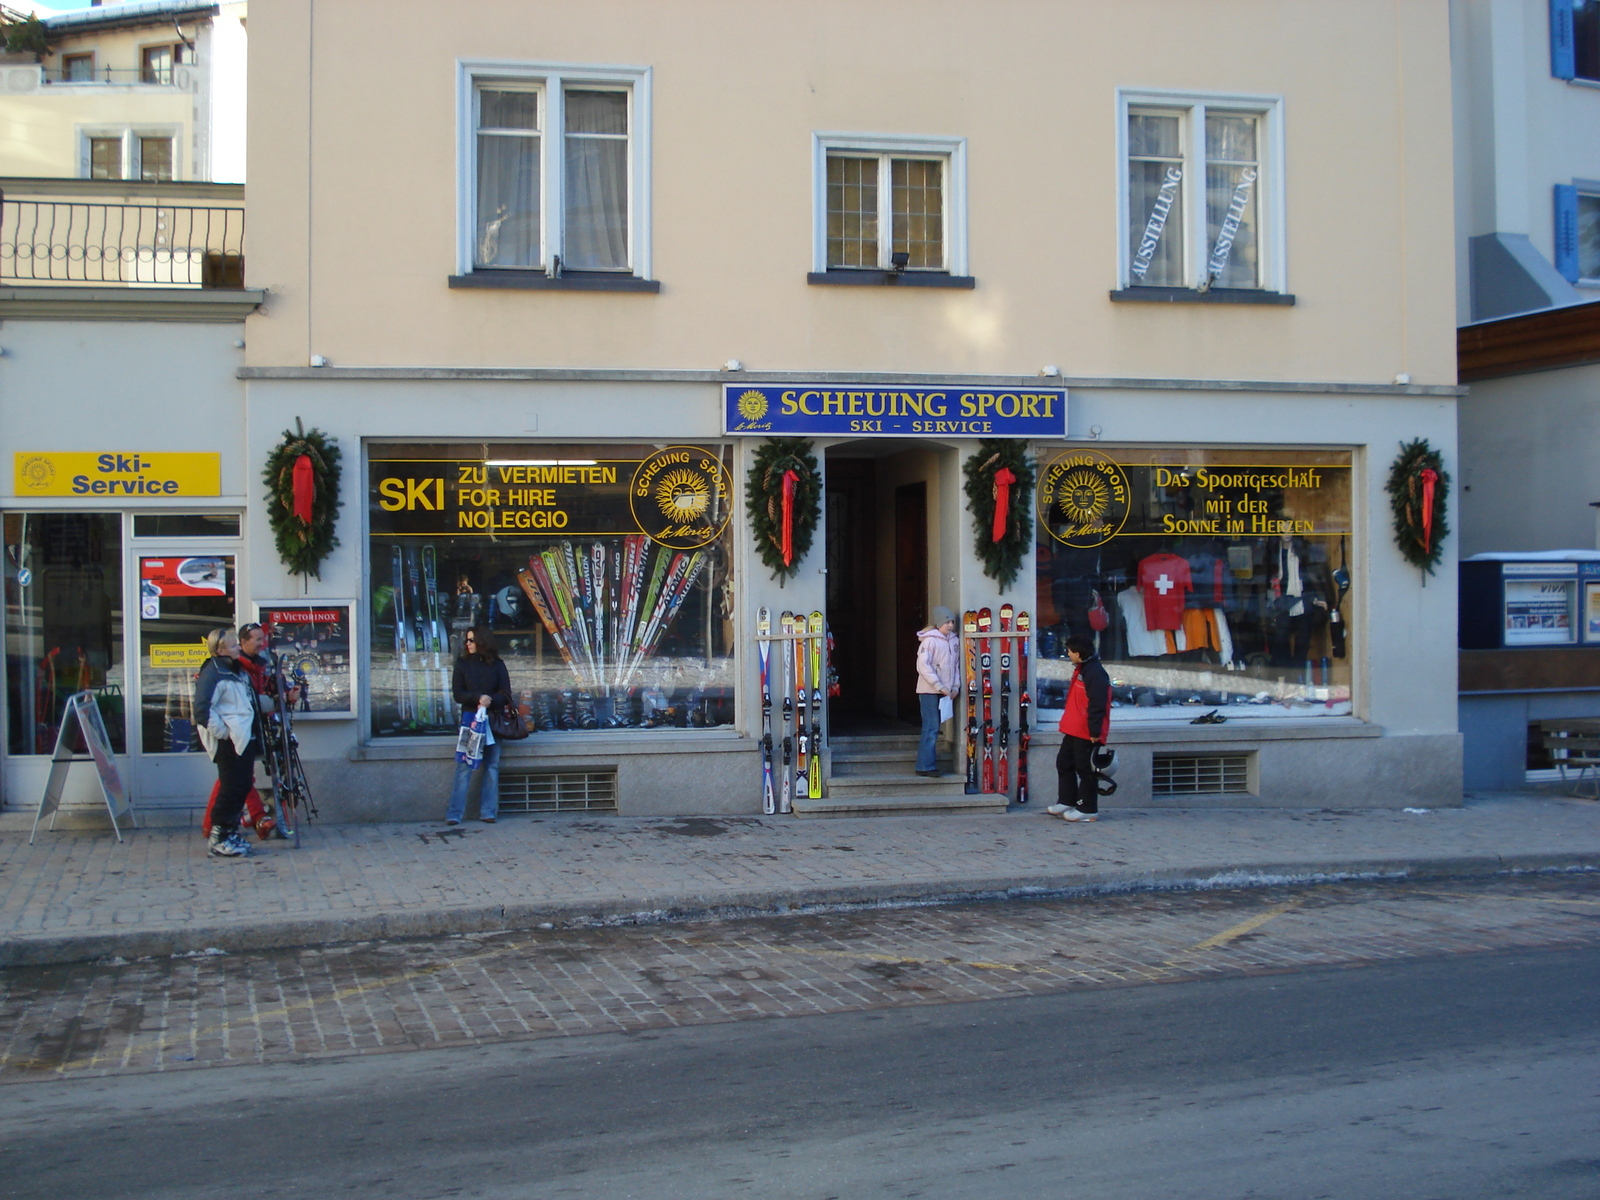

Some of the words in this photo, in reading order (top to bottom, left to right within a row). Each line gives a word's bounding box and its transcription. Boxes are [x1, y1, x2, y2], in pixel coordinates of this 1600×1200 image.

[1131, 166, 1183, 280] AUSSTELLUNG
[1207, 167, 1258, 279] AUSSTELLUNG
[780, 390, 948, 417] SCHEUING
[959, 394, 1058, 418] SPORT
[850, 420, 883, 432] SKI
[912, 421, 993, 433] SERVICE
[97, 453, 152, 473] Ski-
[71, 475, 179, 494] Service
[458, 467, 488, 484] ZU
[500, 467, 617, 484] VERMIETEN
[637, 451, 690, 498] SCHEUING
[699, 458, 727, 499] SPORT
[1042, 455, 1095, 505] SCHEUING
[1095, 460, 1125, 505] SPORT
[378, 477, 445, 512] SKI
[458, 489, 500, 507] FOR
[508, 489, 556, 506] HIRE
[458, 510, 569, 529] NOLEGGIO
[667, 525, 714, 539] Moritz
[1073, 523, 1113, 538] Moritz
[582, 555, 592, 604] SALOMON
[665, 555, 690, 605] ATOMIC
[676, 560, 703, 607] SALOMON
[282, 611, 336, 621] VICTORINOX
[154, 648, 185, 657] Eingang
[188, 648, 209, 657] Entry
